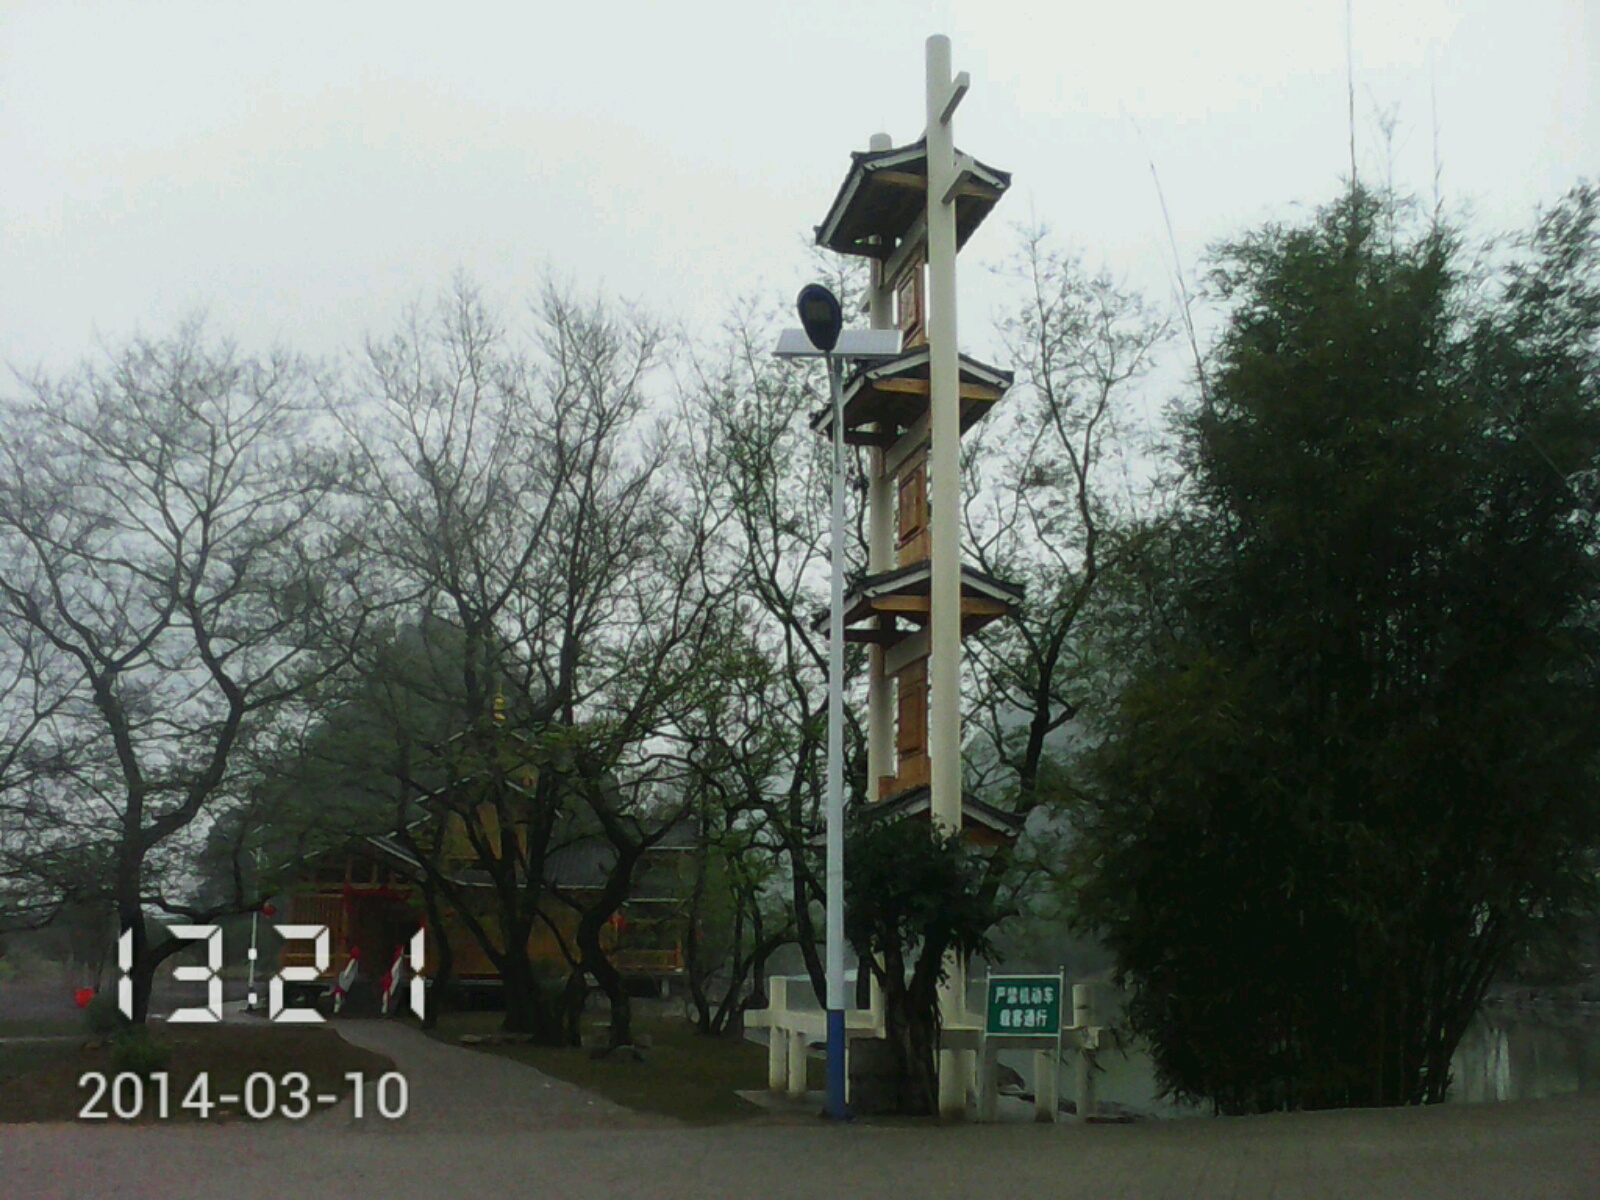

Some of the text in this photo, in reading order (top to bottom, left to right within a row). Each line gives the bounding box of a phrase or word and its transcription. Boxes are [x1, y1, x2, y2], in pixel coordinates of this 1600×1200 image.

[995, 986, 1054, 1005] 严禁机动车
